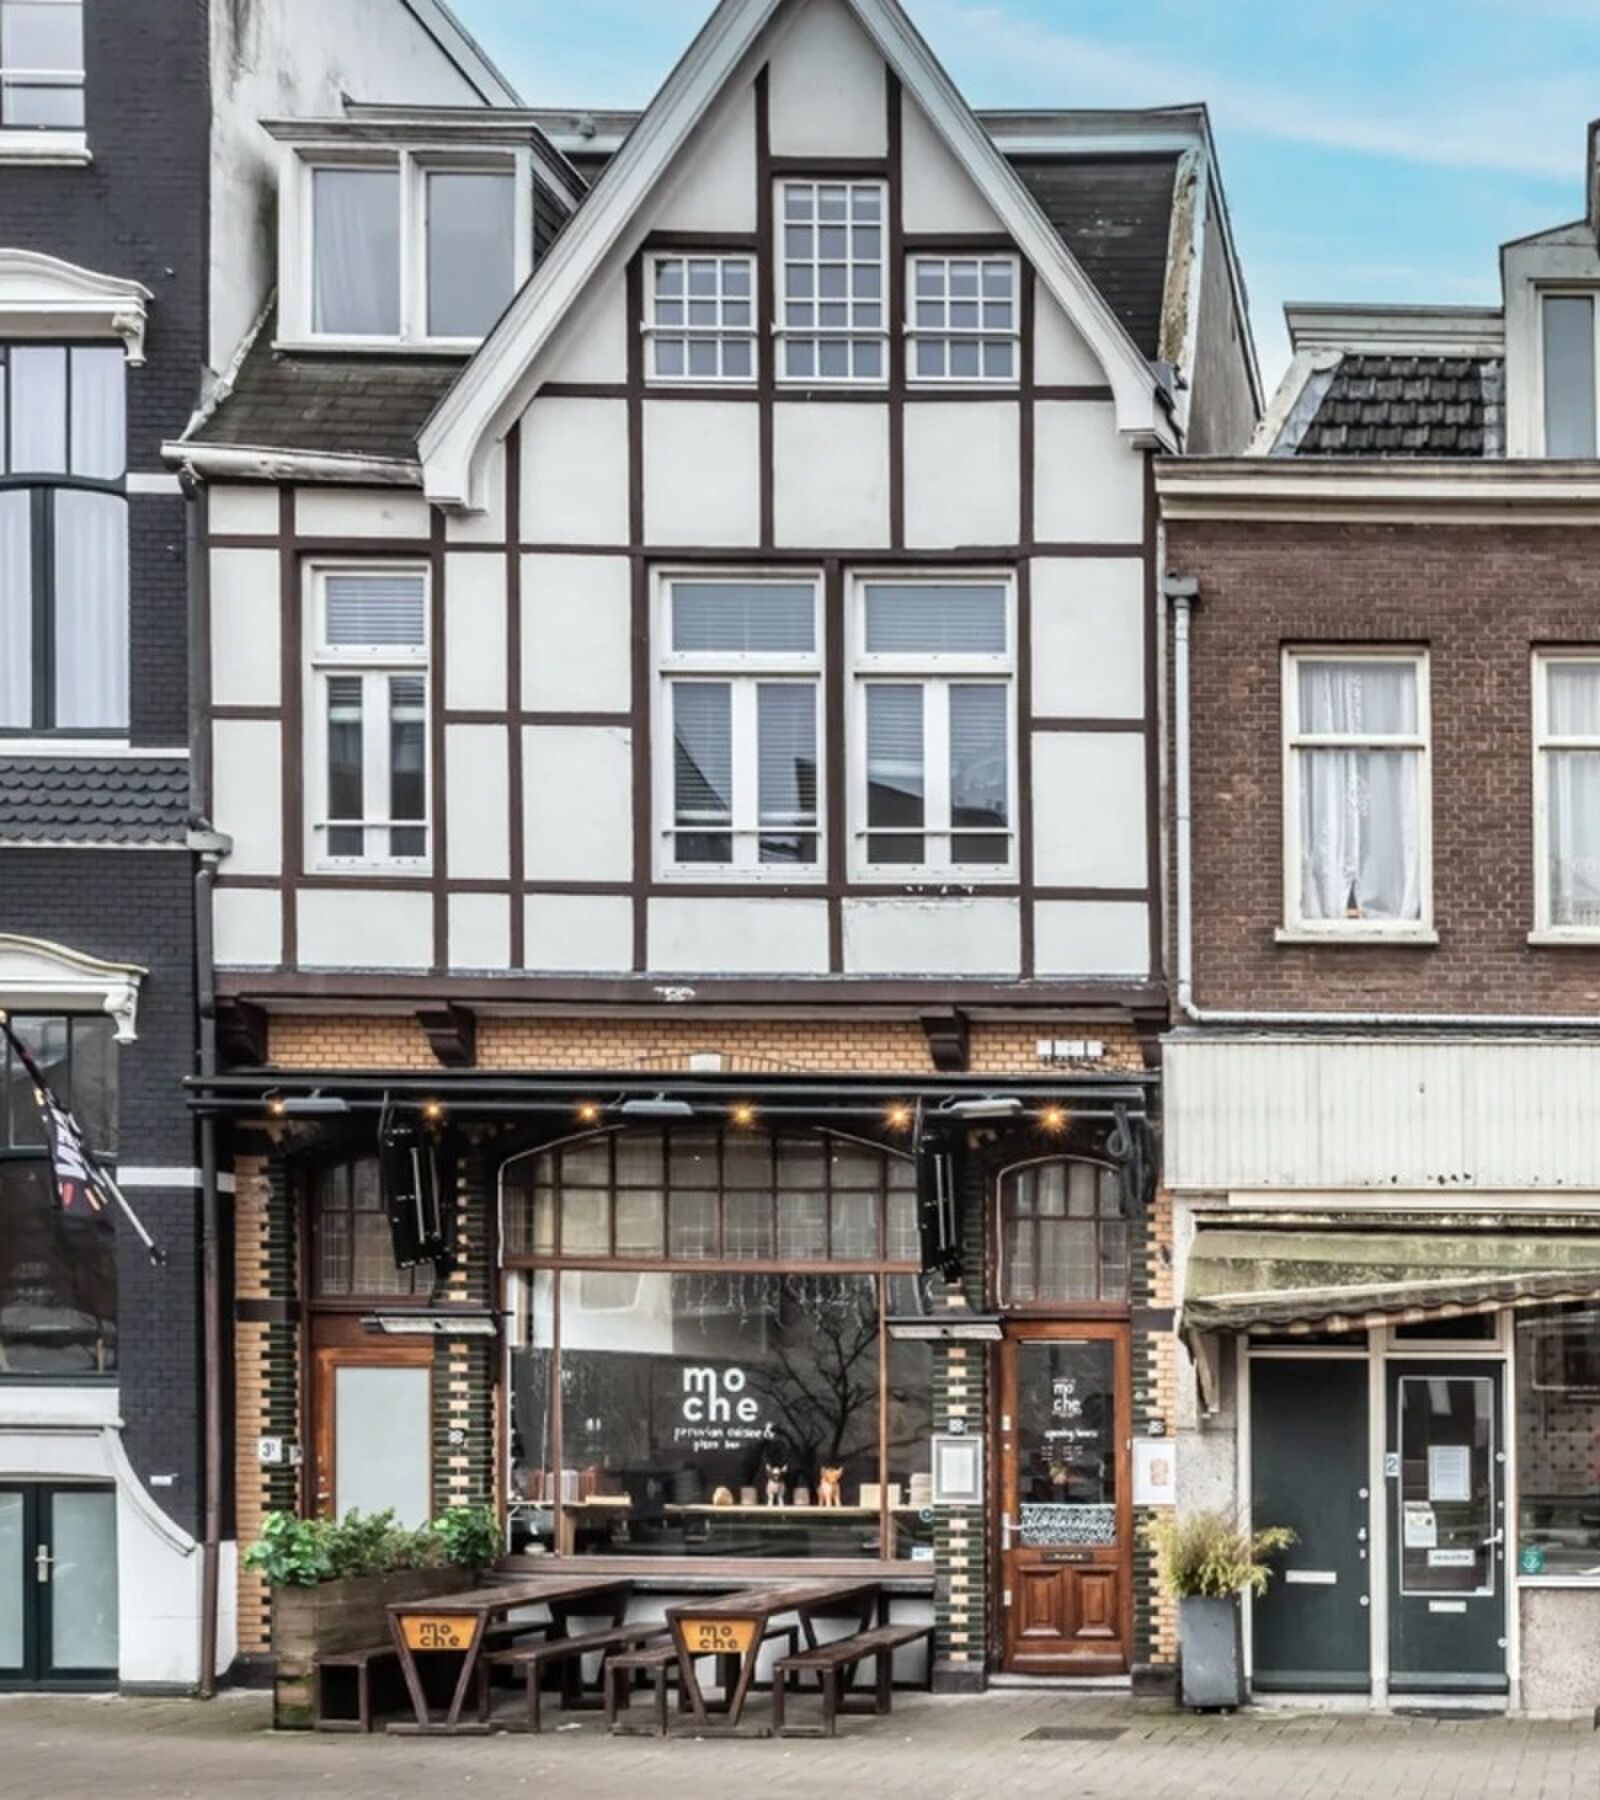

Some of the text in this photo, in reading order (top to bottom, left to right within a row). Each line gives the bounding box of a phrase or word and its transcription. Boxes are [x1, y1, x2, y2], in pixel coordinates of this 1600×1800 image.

[683, 1367, 745, 1393] mo
[682, 1397, 758, 1421] che
[420, 1623, 451, 1635] mo
[700, 1625, 732, 1637] mo
[420, 1635, 460, 1647] che
[699, 1637, 738, 1649] che
